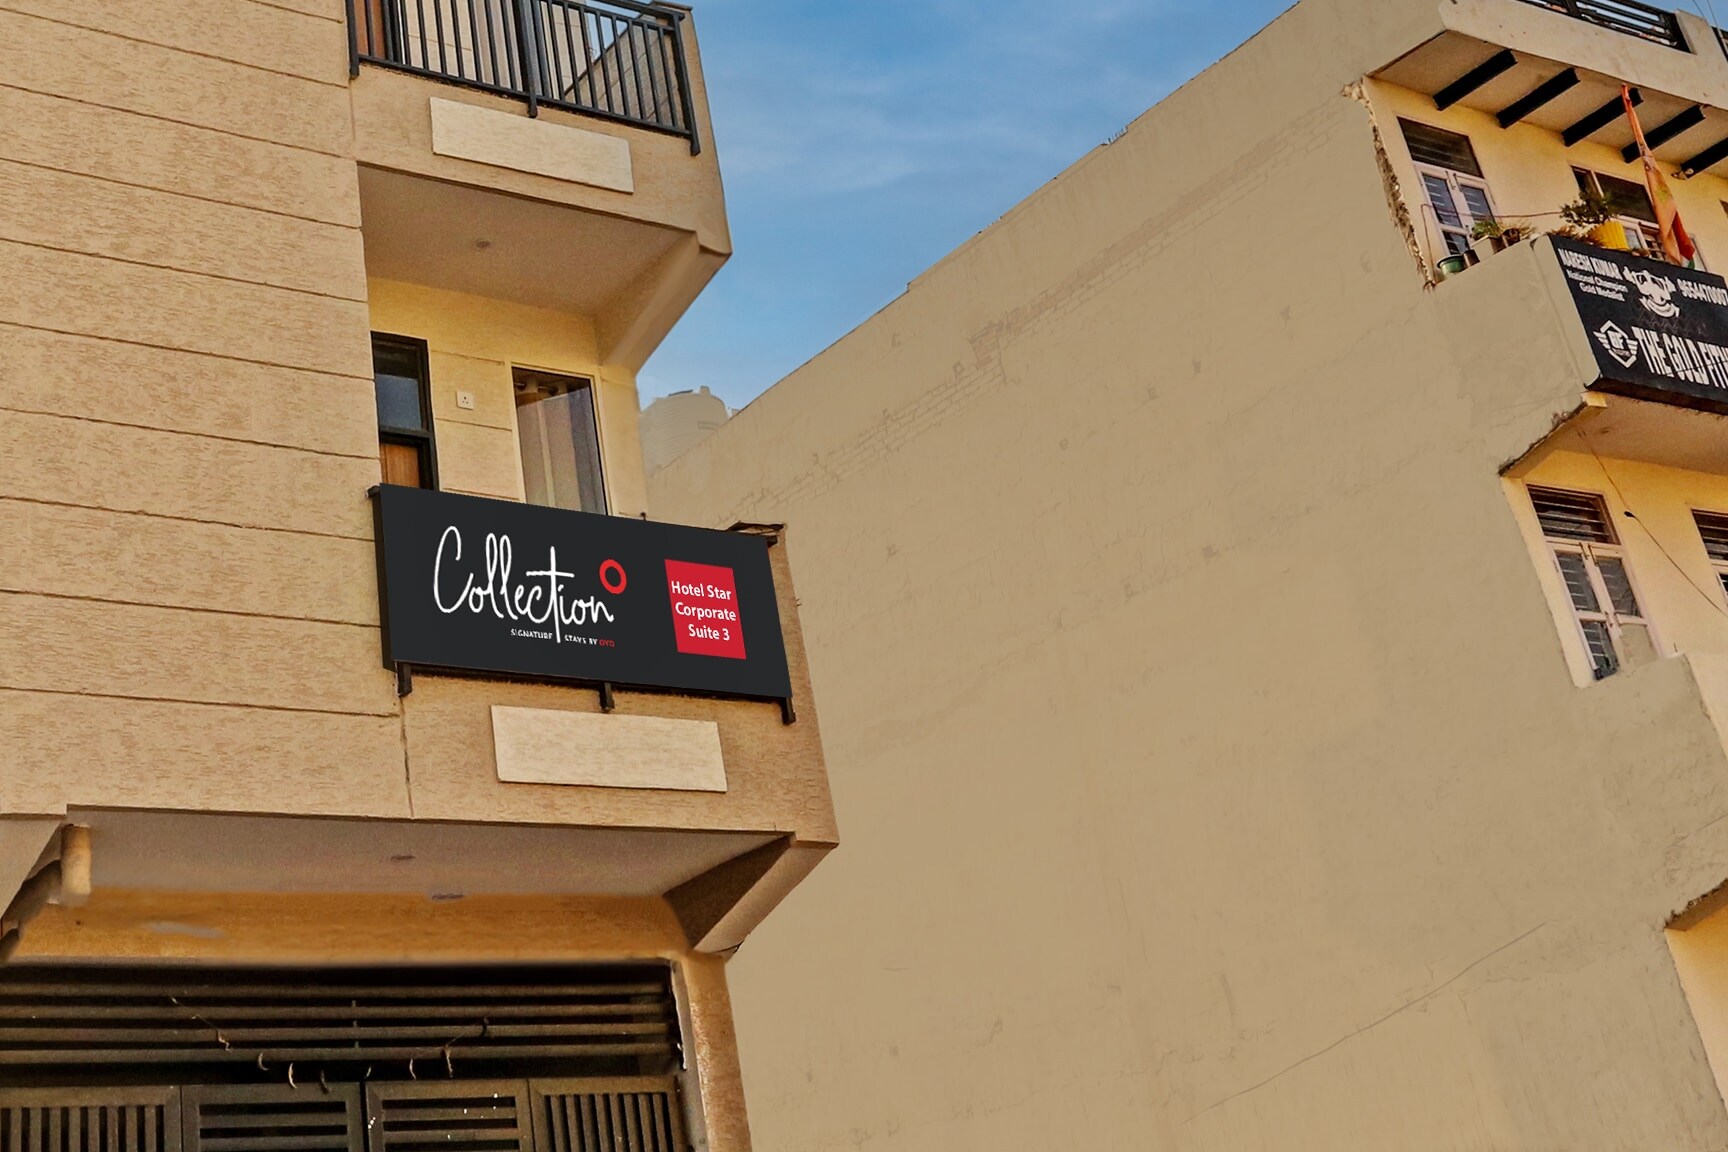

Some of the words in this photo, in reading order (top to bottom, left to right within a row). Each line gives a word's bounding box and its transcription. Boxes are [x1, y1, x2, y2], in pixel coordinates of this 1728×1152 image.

[1558, 248, 1594, 273] NARESH
[1590, 256, 1623, 280] KUMAR
[1631, 326, 1674, 378] THE
[1662, 332, 1710, 385] GOLD
[433, 525, 614, 644] Collection
[671, 580, 704, 597] Hotel
[706, 584, 731, 600] Star
[675, 601, 737, 621] Corporate
[510, 628, 553, 640] SIGNATURE
[564, 634, 587, 644] STAYS
[688, 623, 720, 640] Suite
[722, 628, 730, 641] 3
